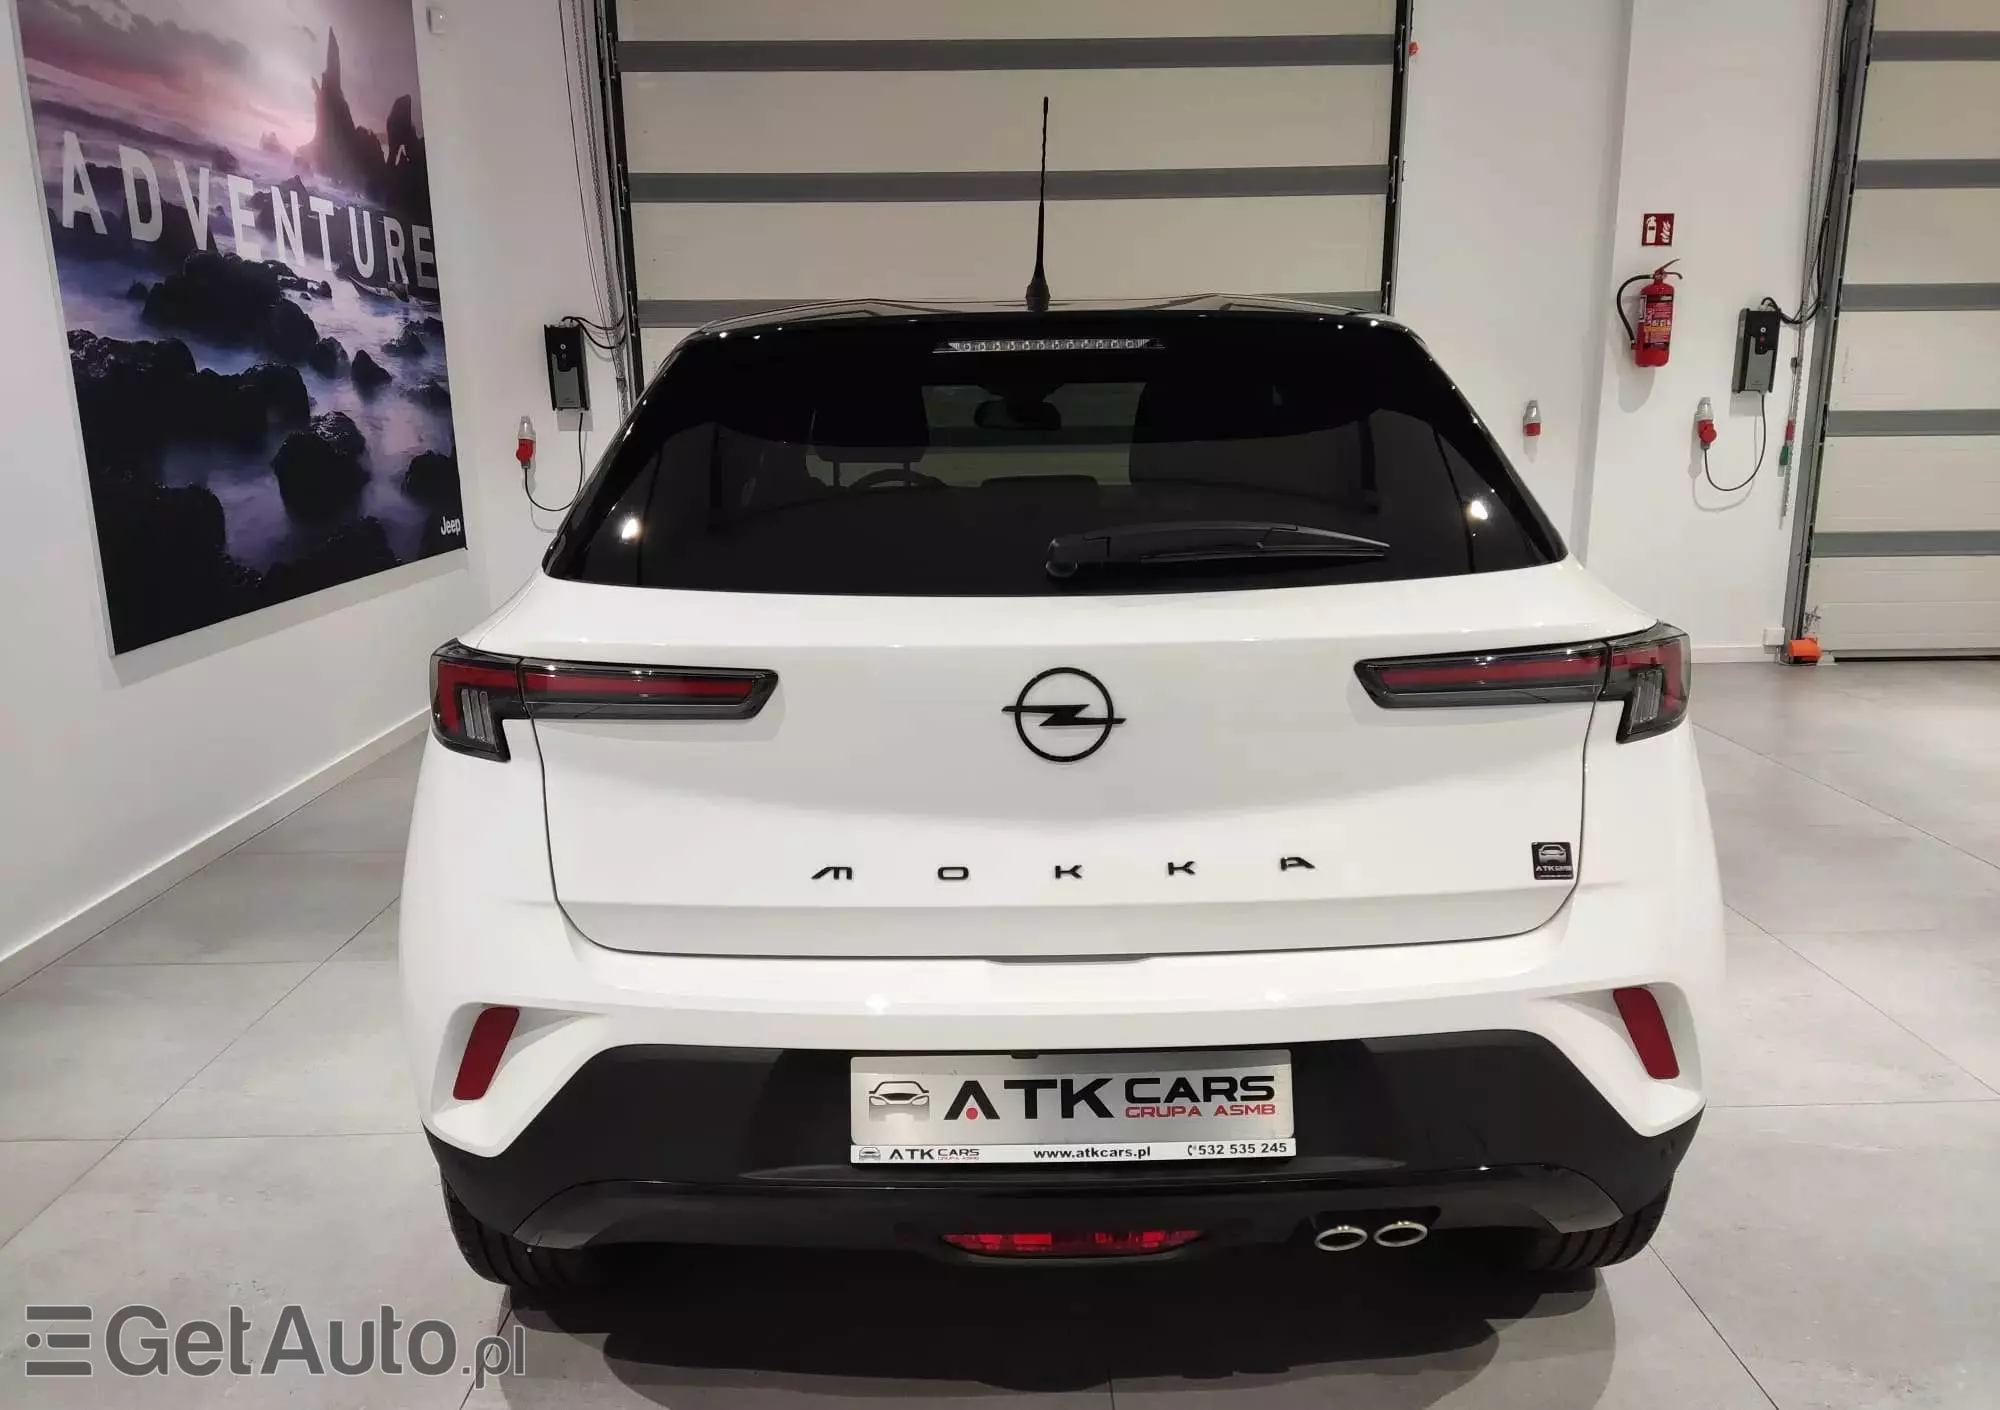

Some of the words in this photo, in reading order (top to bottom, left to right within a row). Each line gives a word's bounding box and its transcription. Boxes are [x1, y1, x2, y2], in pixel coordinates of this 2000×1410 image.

[61, 130, 437, 289] ADVENTURE
[440, 515, 461, 537] Jeep
[811, 856, 1315, 881] MOKKA
[943, 1078, 1115, 1120] ATK
[1124, 1075, 1275, 1104] CARS
[1125, 1104, 1203, 1118] GRUPA
[1213, 1103, 1276, 1116] ASMB
[889, 1148, 935, 1160] ATK
[937, 1148, 980, 1157] CARS
[1033, 1145, 1151, 1159] www.atkcars.pl
[1199, 1144, 1225, 1155] 532
[1230, 1143, 1256, 1154] 535
[1261, 1142, 1287, 1153] 245
